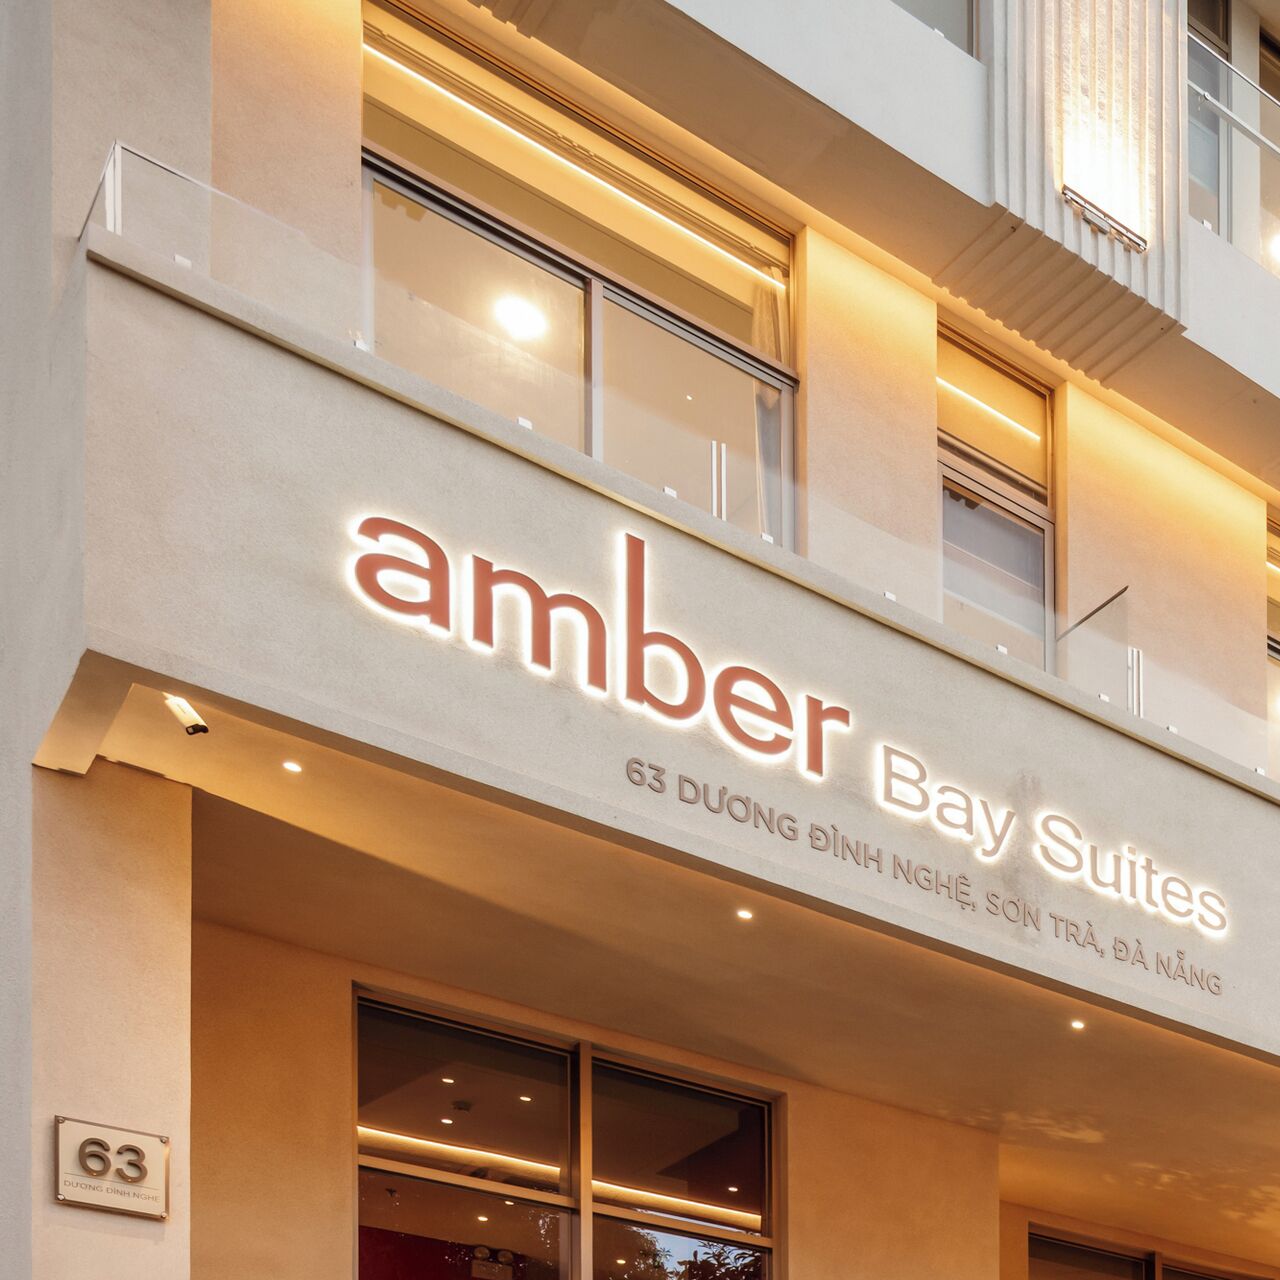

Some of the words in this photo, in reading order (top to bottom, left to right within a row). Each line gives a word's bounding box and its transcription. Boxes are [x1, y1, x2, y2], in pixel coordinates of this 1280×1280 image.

[354, 515, 851, 778] amber
[882, 743, 1017, 858] Bay
[1039, 813, 1228, 932] Suites
[625, 756, 667, 794] 63
[677, 773, 799, 842] DƯƠNG
[808, 822, 883, 874] ĐÌNH
[892, 853, 977, 911] NGHỆ,
[985, 890, 1042, 932] SƠN
[1049, 912, 1105, 958] TRÀ,
[1111, 936, 1149, 971] ĐÀ
[78, 1137, 149, 1184] 63
